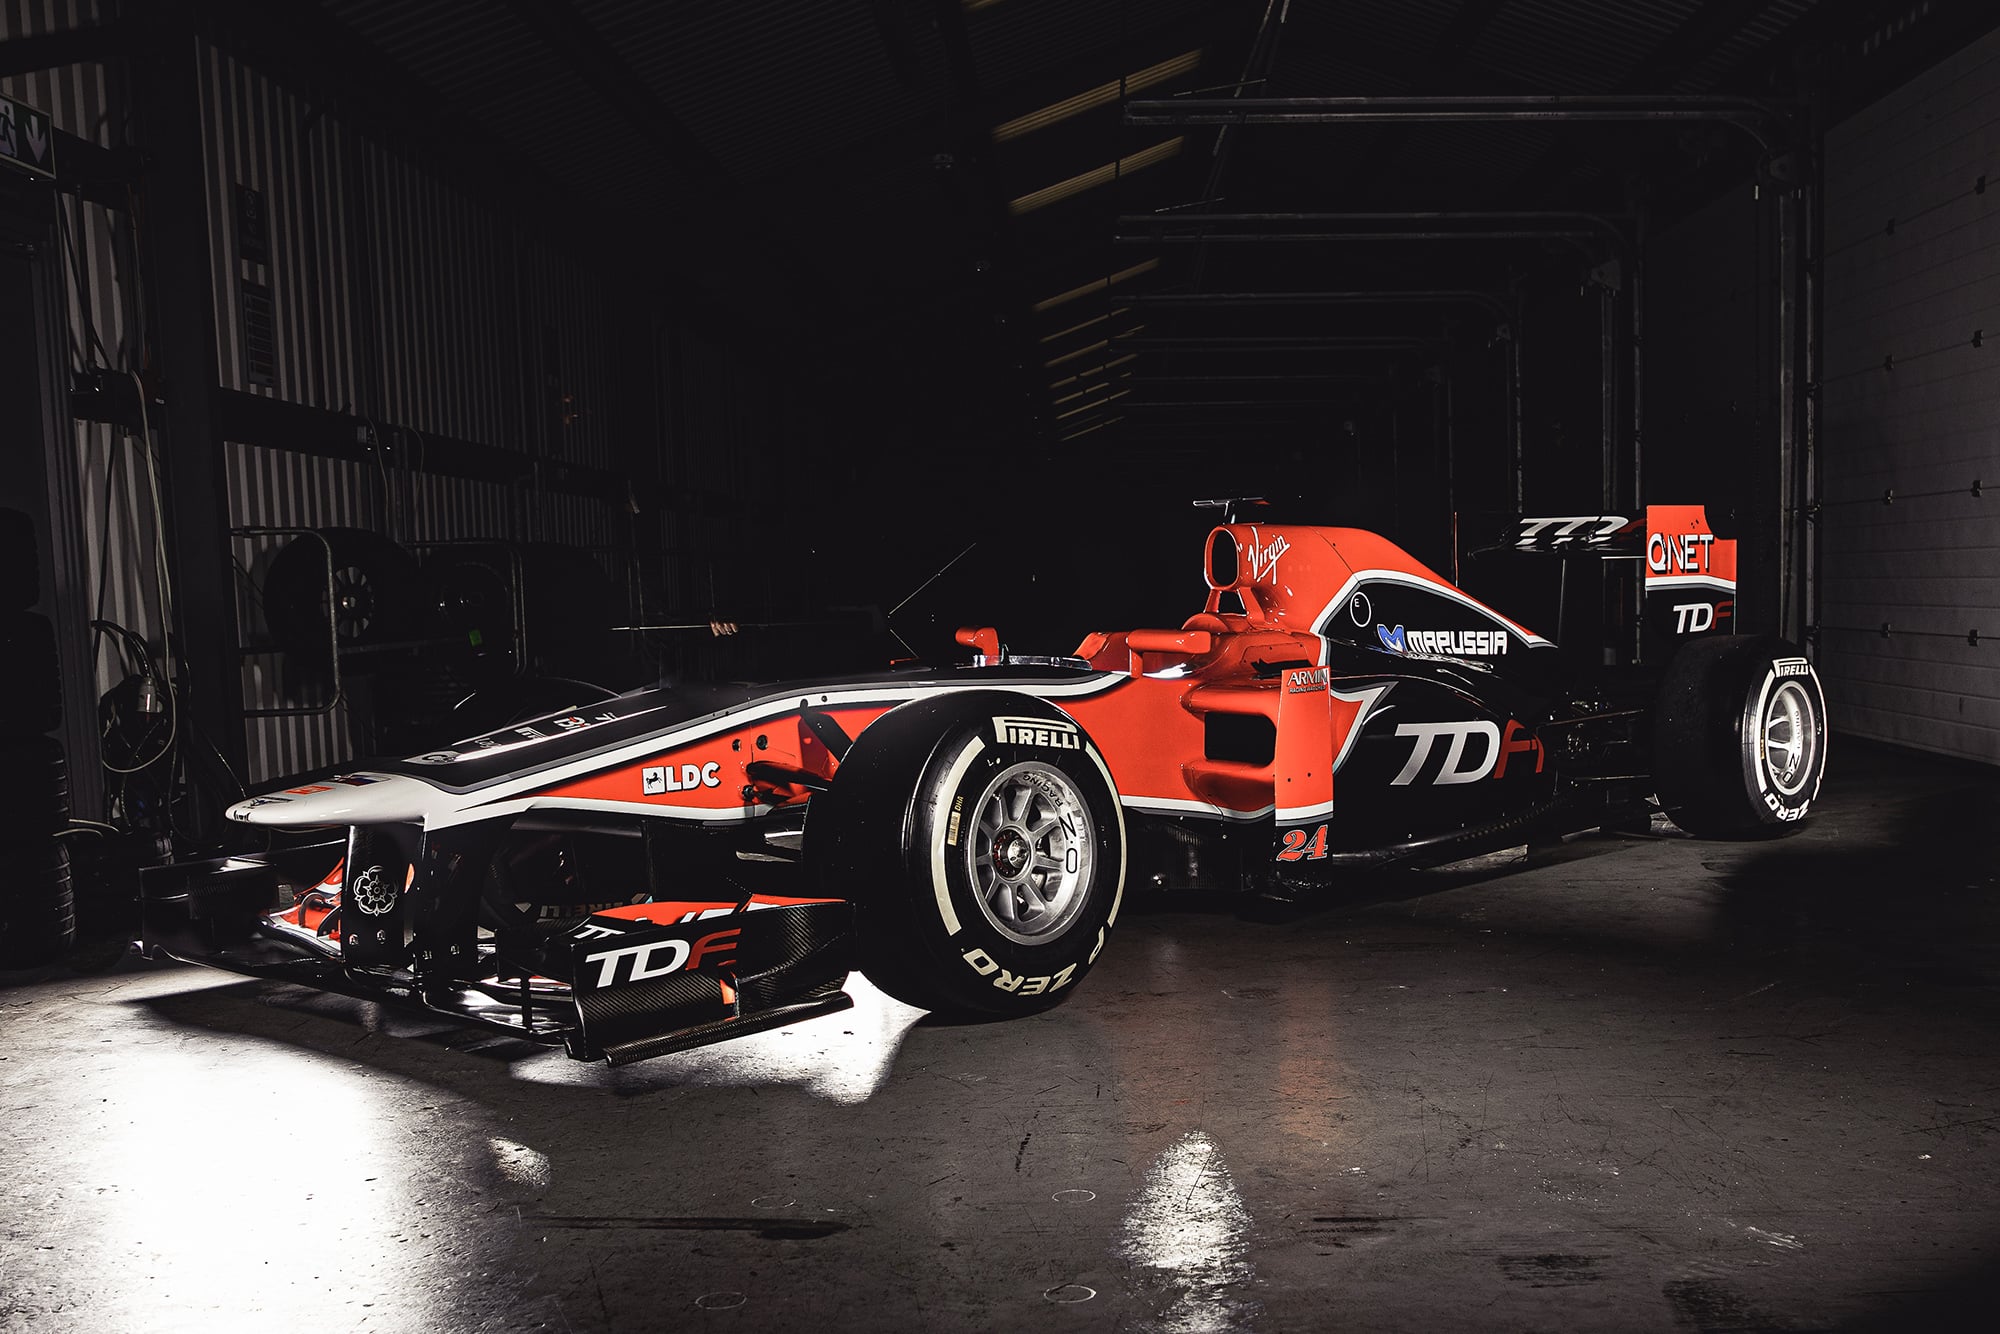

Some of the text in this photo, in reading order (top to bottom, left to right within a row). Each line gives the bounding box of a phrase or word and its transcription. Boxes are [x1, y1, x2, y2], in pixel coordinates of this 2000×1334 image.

[1247, 525, 1291, 586] Virgin
[1672, 600, 1734, 634] TDF
[1406, 630, 1508, 655] MARUSSIA
[1771, 656, 1809, 678] PIRELLI
[991, 716, 1081, 750] PIRELLI
[1389, 719, 1545, 786] TDF
[665, 761, 720, 793] LDC
[1022, 774, 1064, 808] RACING
[1764, 793, 1811, 822] ZERO
[1275, 823, 1330, 863] 24
[584, 927, 742, 989] TDF
[961, 946, 1078, 997] ZERO
